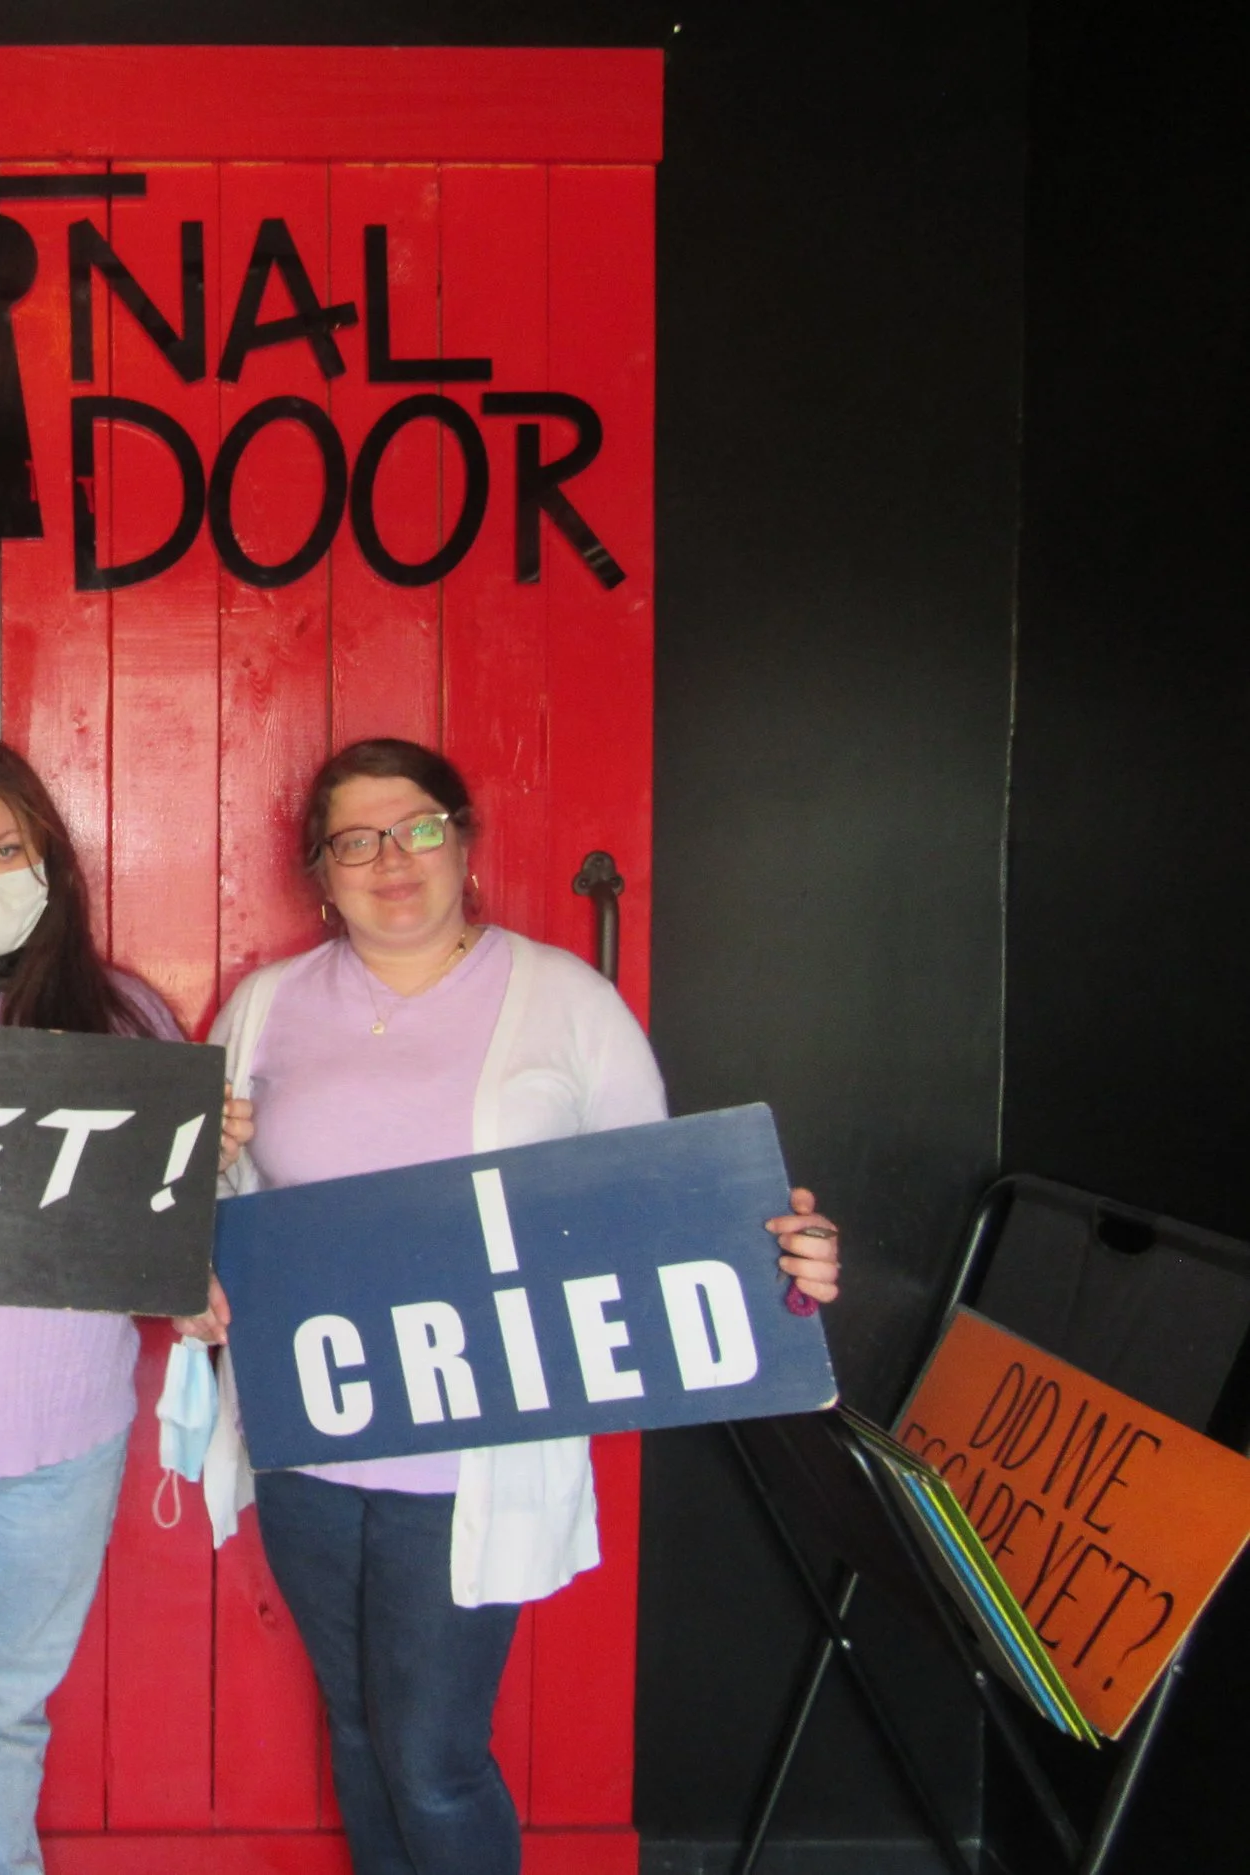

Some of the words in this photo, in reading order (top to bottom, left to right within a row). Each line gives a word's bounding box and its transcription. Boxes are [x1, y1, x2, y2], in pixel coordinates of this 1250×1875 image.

[71, 392, 628, 591] DOOR
[472, 1168, 519, 1274] I
[292, 1259, 759, 1437] CRIED
[969, 1362, 1060, 1471] DID
[1041, 1399, 1162, 1534] WE
[1021, 1521, 1175, 1691] YET?
